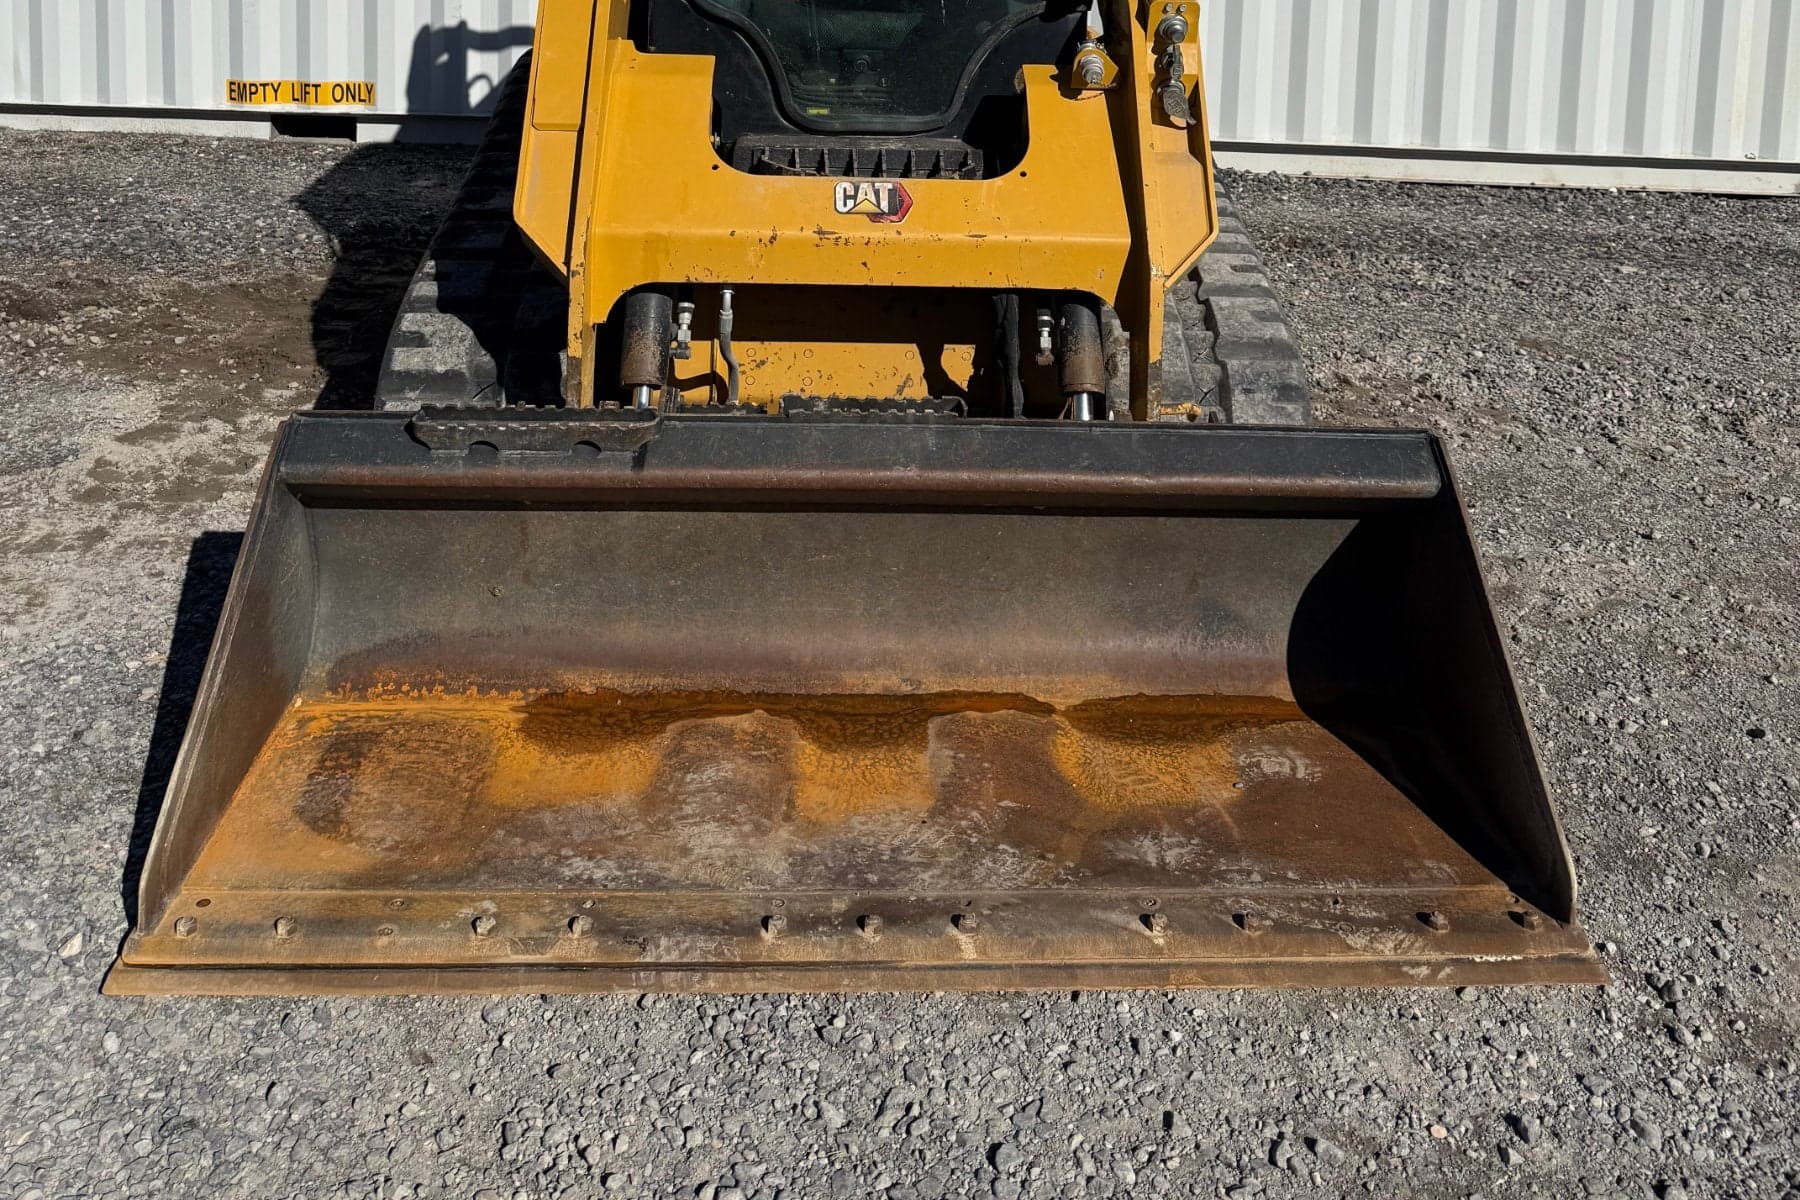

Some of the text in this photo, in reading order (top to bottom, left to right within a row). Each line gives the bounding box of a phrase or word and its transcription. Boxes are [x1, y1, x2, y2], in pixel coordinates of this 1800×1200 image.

[229, 81, 374, 103] EMPTY LIFT ONLY
[835, 181, 893, 214] CAT
